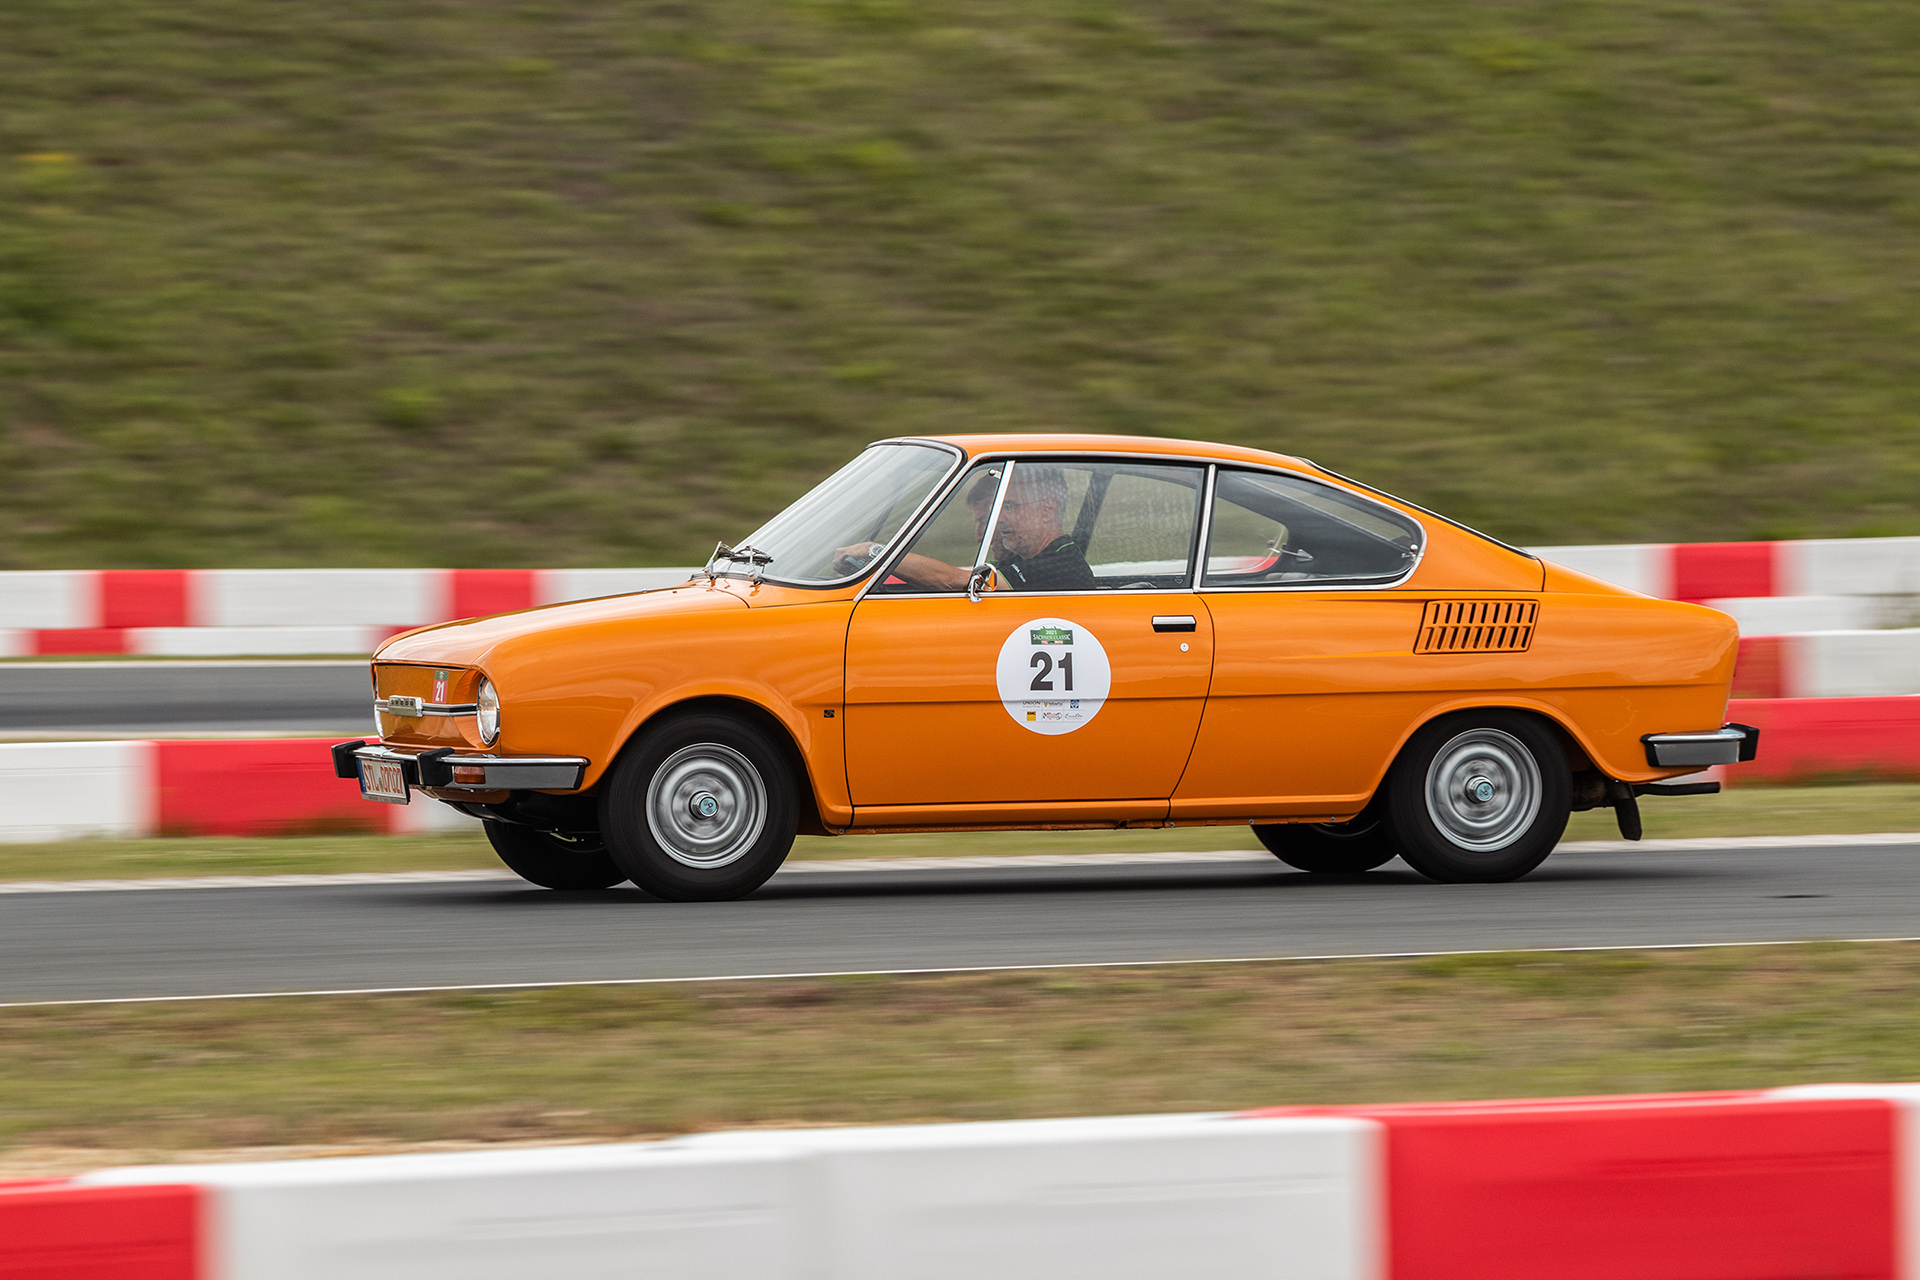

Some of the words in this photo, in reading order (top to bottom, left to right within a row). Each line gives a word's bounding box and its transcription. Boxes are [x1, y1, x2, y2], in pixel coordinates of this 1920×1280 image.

[1030, 651, 1073, 691] 21
[435, 681, 444, 702] 21
[363, 764, 380, 791] STL
[381, 766, 404, 794] 07027
